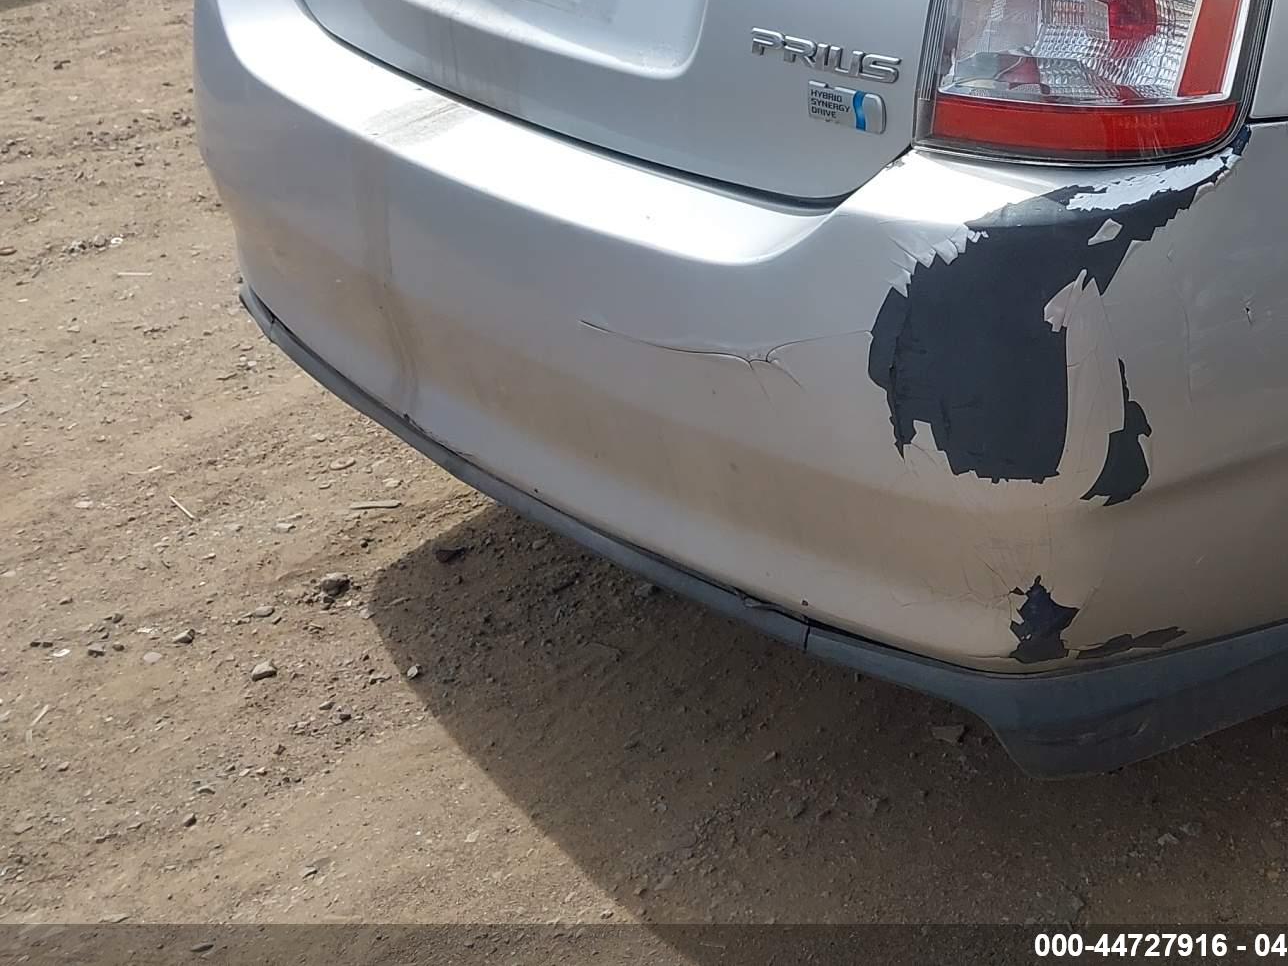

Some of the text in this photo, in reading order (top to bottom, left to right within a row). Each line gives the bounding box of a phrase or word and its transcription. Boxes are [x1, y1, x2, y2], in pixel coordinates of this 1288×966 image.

[750, 25, 903, 85] PRIUS
[810, 89, 843, 103] HYBRID
[810, 98, 851, 113] SYNERGY
[810, 106, 838, 119] DRIVE
